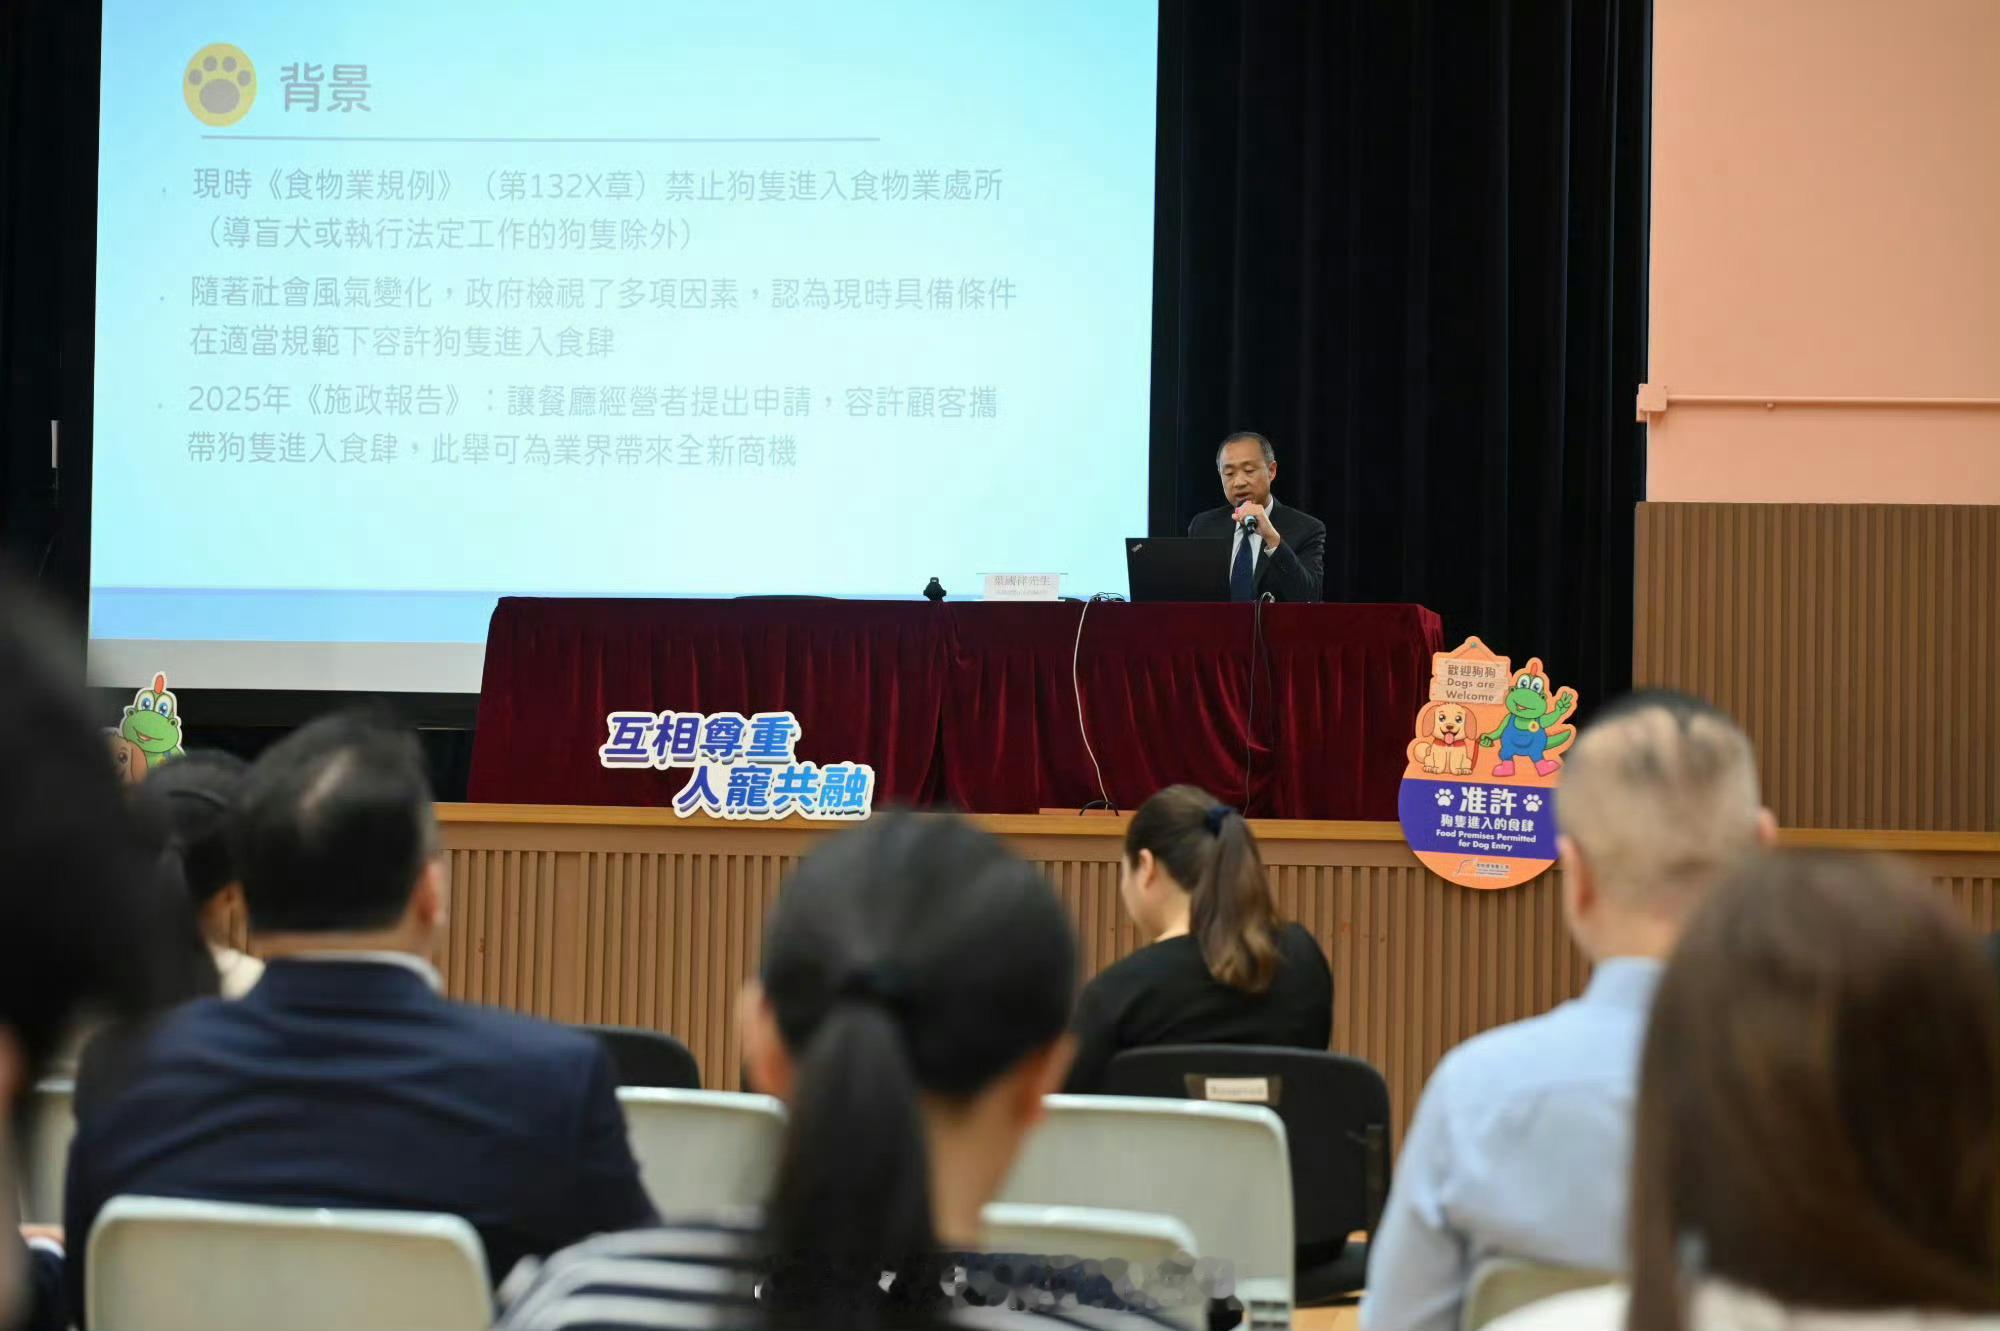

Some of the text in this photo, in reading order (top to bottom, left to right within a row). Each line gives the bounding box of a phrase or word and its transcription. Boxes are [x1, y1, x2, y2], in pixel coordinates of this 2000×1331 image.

[280, 62, 372, 113] 背景
[190, 325, 614, 359] 在適當規範下容許狗隻進入食肆
[1448, 664, 1496, 678] 歡迎狗狗
[1447, 678, 1473, 689] Dogs
[1446, 690, 1495, 701] Welcome
[603, 714, 796, 761] 互相尊重
[676, 765, 868, 811] 人寵共融
[1460, 786, 1517, 815] 准許
[1440, 814, 1535, 832] 狗隻進入的食肆
[1436, 829, 1537, 843] Food Premises Permitted
[1458, 839, 1513, 852] for Dog Entry
